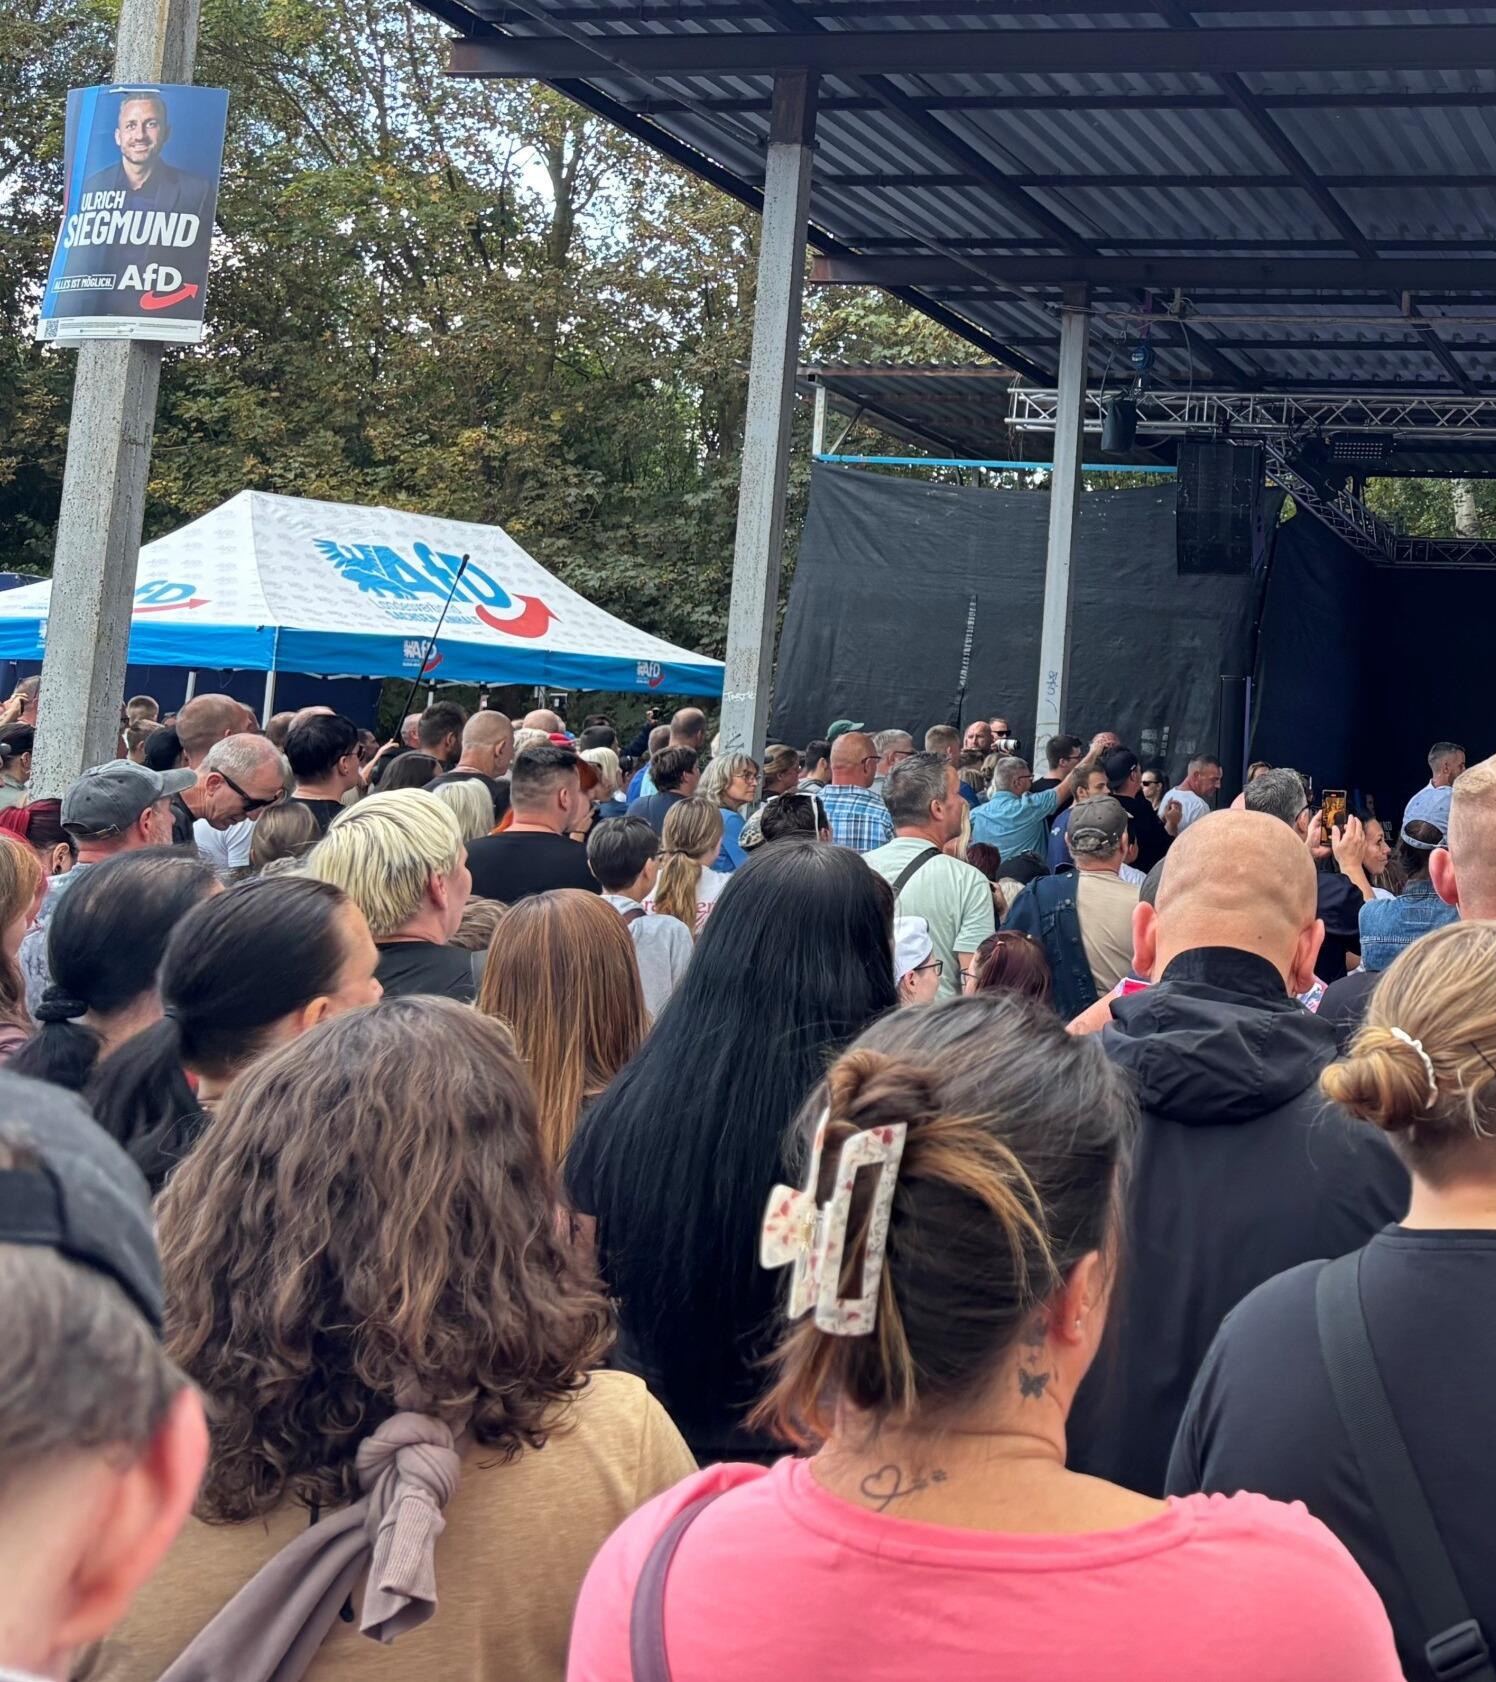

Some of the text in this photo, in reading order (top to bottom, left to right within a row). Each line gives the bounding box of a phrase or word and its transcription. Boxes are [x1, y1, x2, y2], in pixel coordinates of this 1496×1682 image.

[81, 190, 126, 211] ULRICH
[63, 210, 201, 249] SIEGMUND
[53, 279, 72, 290] ALLES
[71, 278, 82, 289] IST
[117, 263, 183, 292] AfD
[370, 541, 513, 609] AfD
[135, 579, 197, 604] fD
